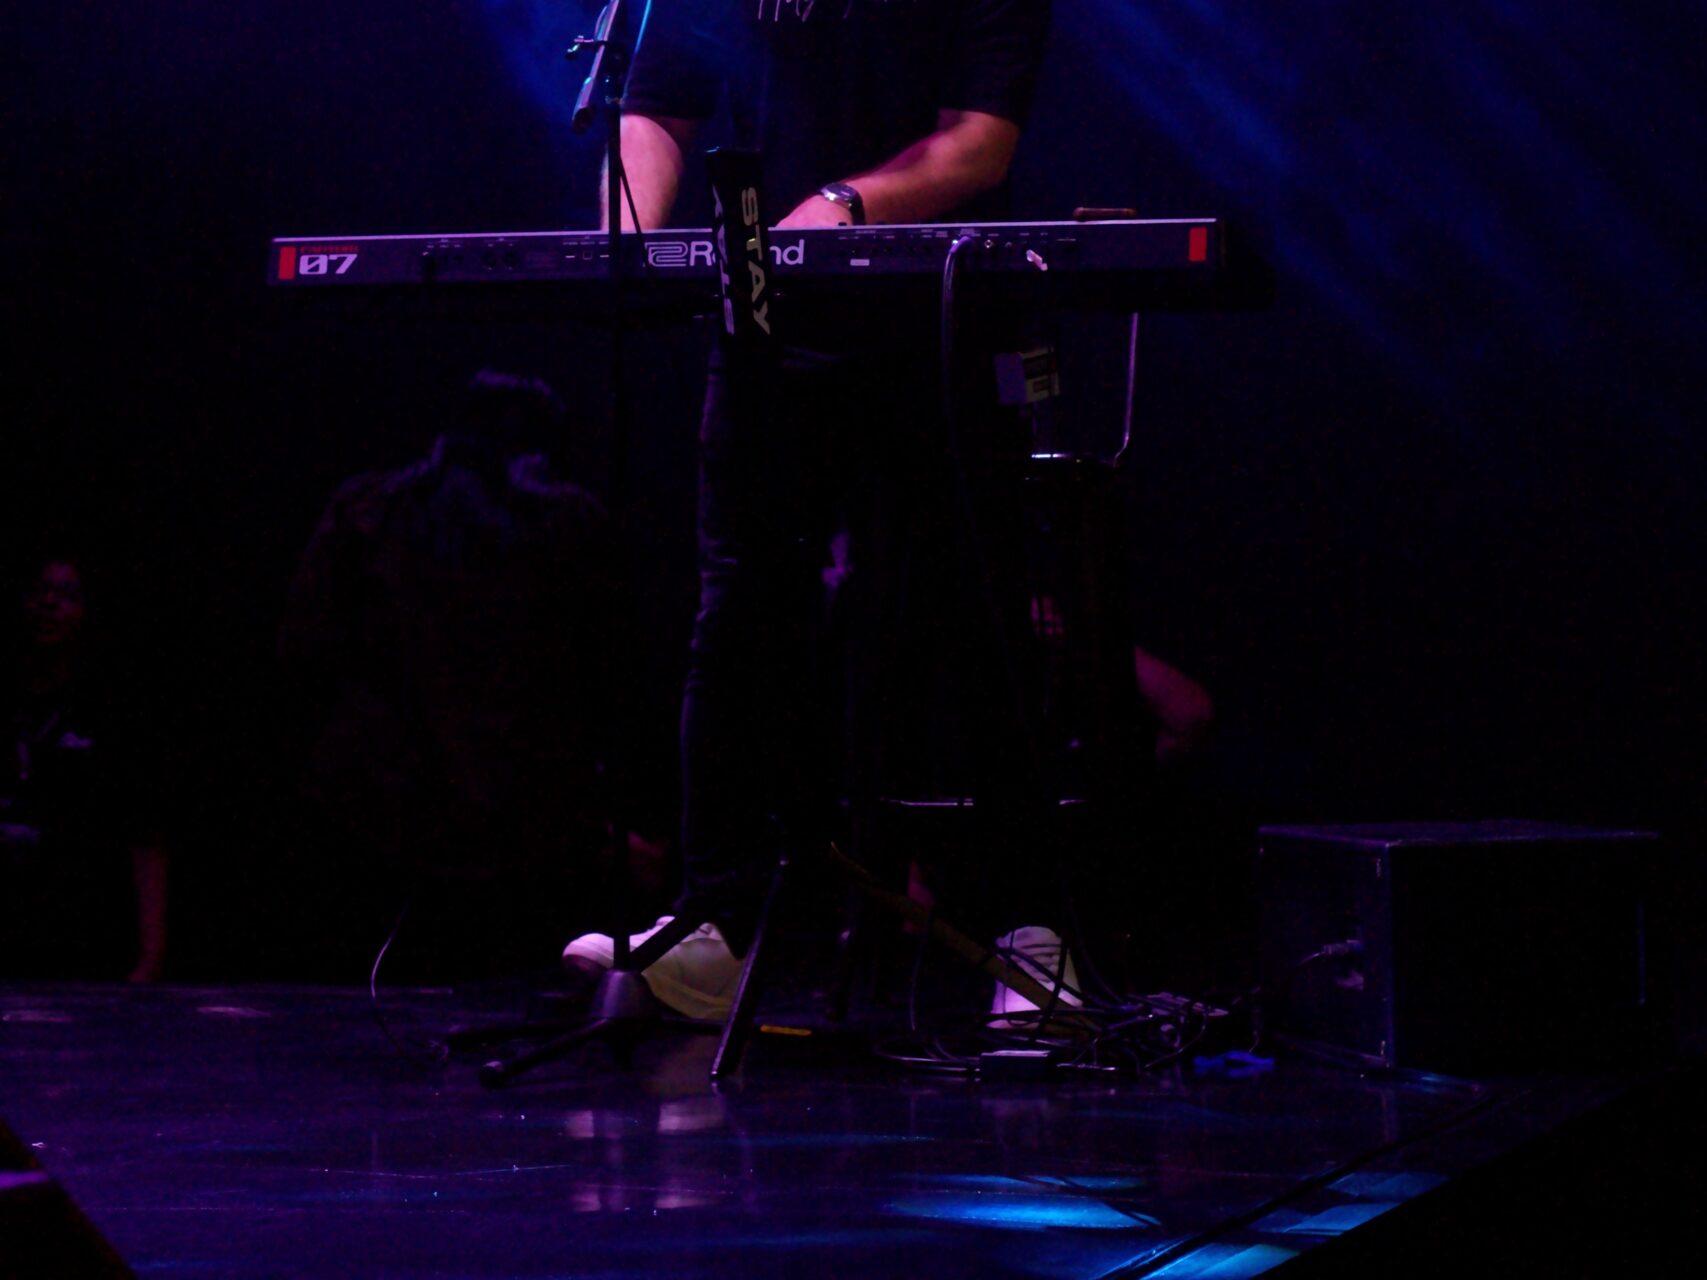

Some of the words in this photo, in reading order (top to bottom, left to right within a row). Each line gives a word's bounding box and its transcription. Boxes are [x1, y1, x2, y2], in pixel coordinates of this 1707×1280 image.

[299, 253, 358, 275] 07
[689, 238, 805, 268] Rnd
[741, 186, 772, 337] STAY
